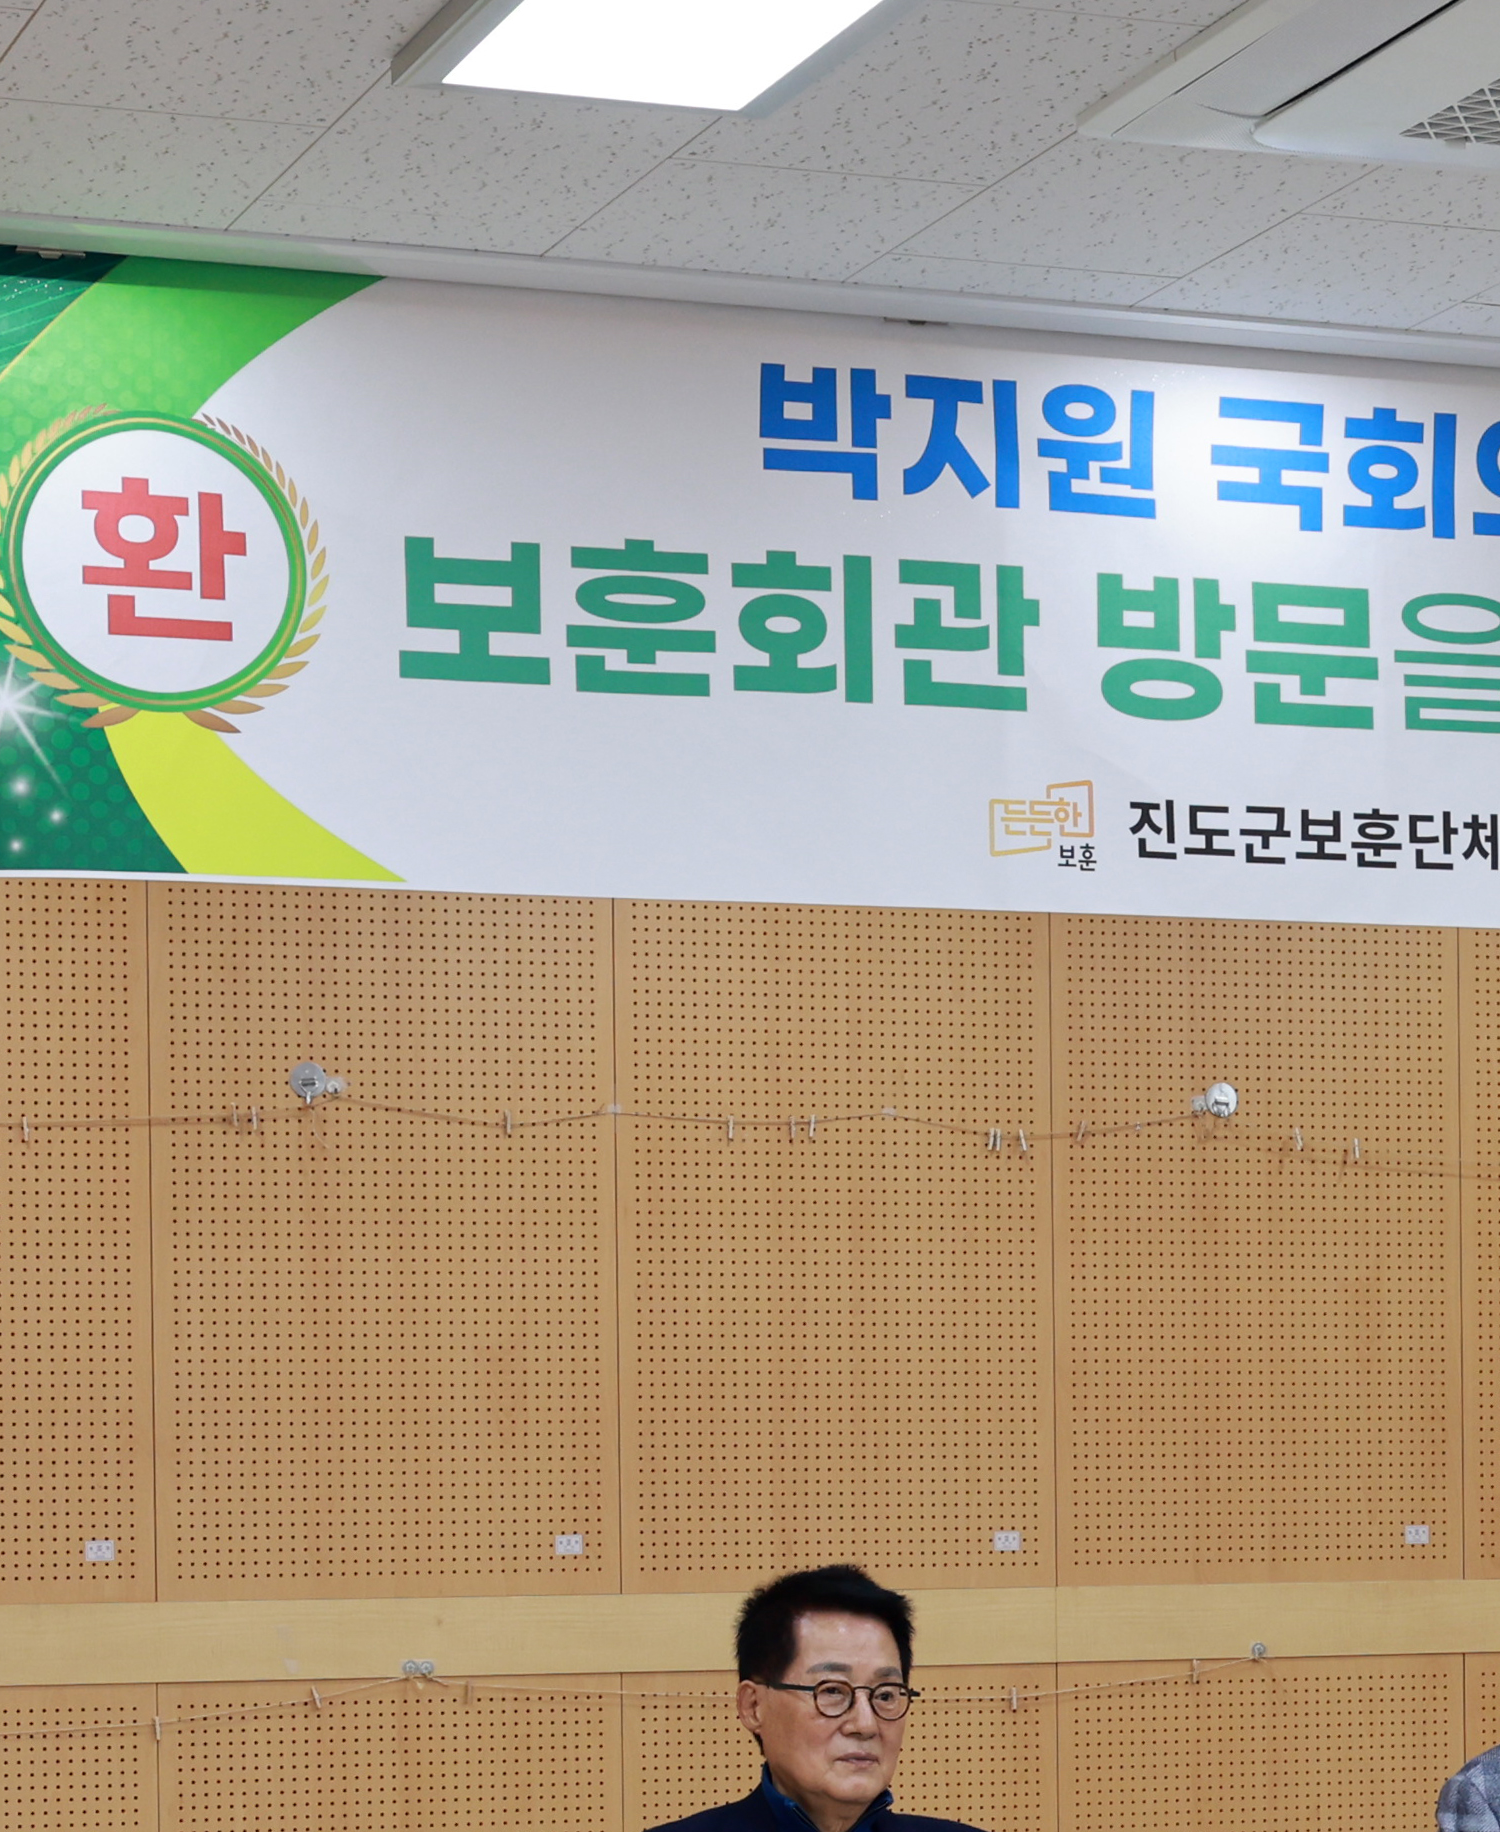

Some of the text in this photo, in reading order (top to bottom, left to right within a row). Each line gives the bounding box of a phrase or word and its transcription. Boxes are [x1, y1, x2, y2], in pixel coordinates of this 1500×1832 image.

[759, 362, 1157, 519] 박지원
[80, 476, 248, 642] 환
[399, 536, 1041, 711] 보훈회관
[1000, 796, 1083, 839] 든든한
[1057, 842, 1097, 872] 보훈
